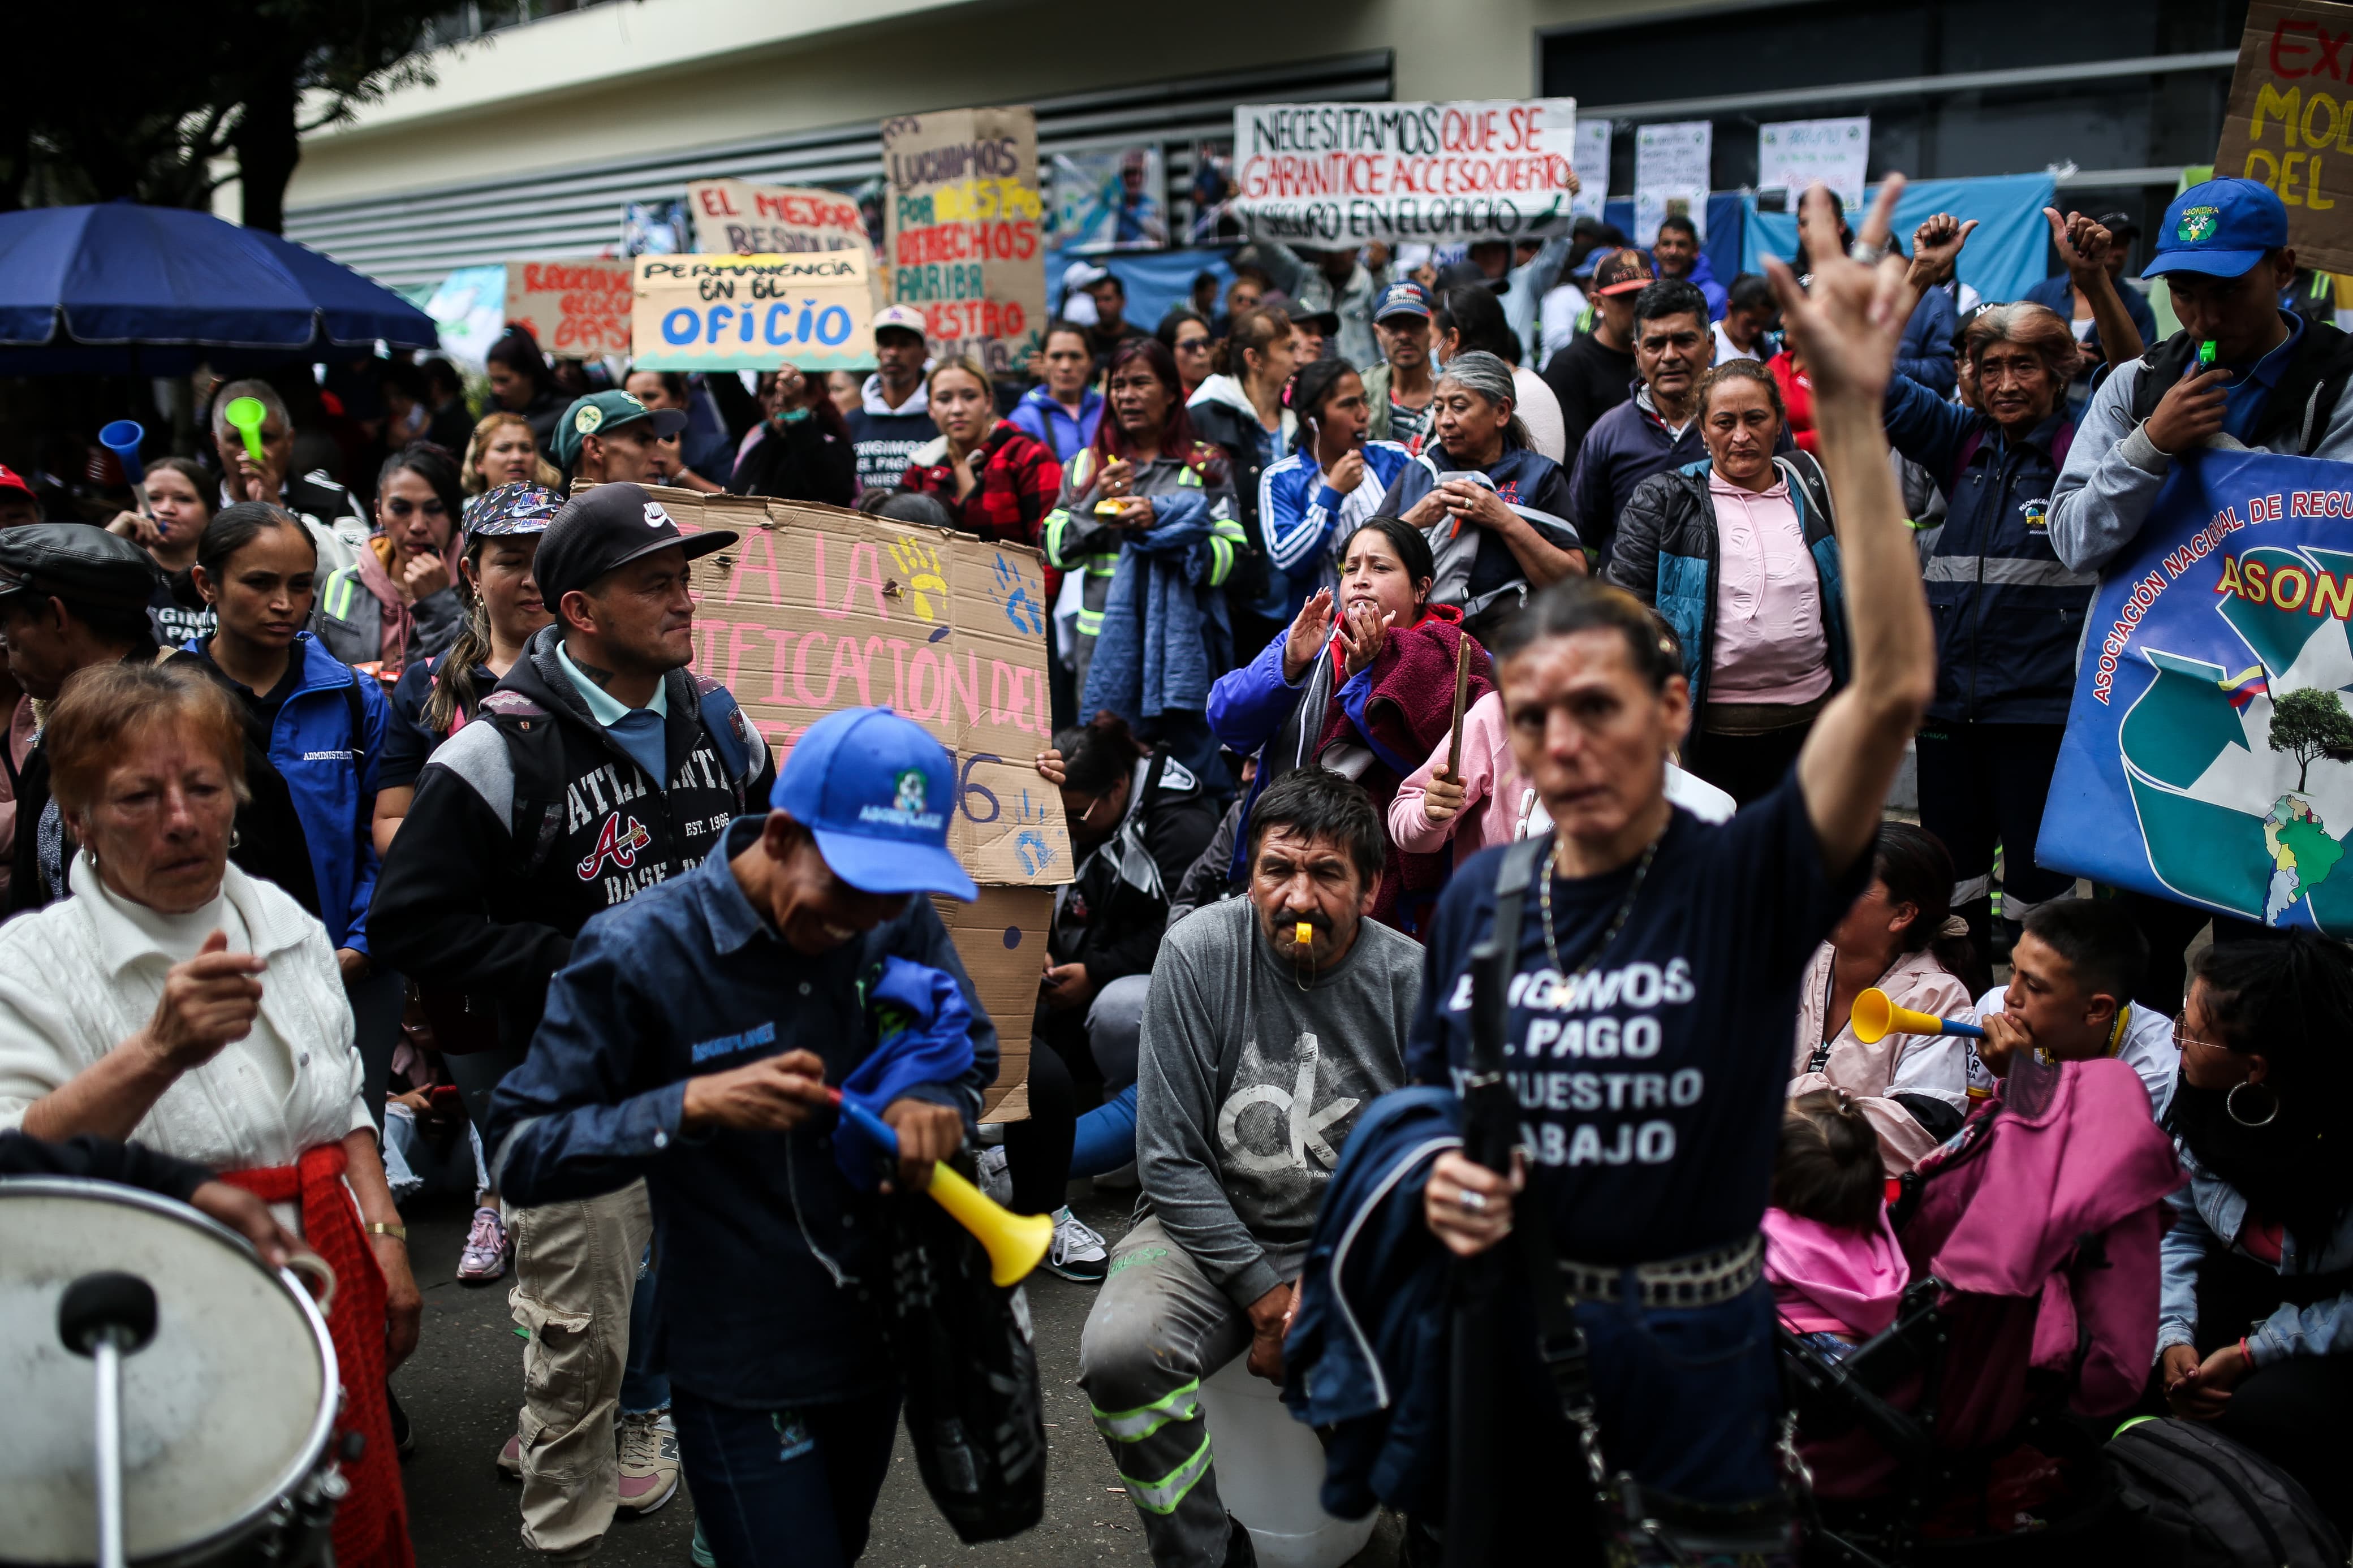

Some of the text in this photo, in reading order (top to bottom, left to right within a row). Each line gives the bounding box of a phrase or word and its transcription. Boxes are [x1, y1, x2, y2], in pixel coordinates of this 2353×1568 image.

[2269, 18, 2353, 85] EX
[1253, 106, 1544, 154] NECESITAMOS QUE SE
[1240, 153, 1387, 199] GARANTICE
[2244, 149, 2334, 210] DEL
[700, 189, 870, 236] EL MEJOR
[897, 194, 933, 231] POR
[1350, 198, 1391, 237] EN
[1397, 198, 1428, 233] EL
[1428, 198, 1522, 234] OFICIO
[2182, 207, 2219, 217] ASONDRA
[897, 219, 1037, 266] DERECHOS
[700, 277, 786, 301] EN EL
[662, 299, 852, 347] OFICIO
[923, 299, 1025, 342] UESTRO
[518, 493, 548, 507] NIKE
[726, 527, 888, 621] A LA
[2093, 571, 2166, 706] ASOCIACIÓN
[2162, 506, 2245, 579] NACIONAL
[2248, 494, 2283, 525] DE
[990, 659, 1051, 736] DEL
[685, 812, 730, 837] EST. 1966
[1525, 1015, 1662, 1059] PAGO
